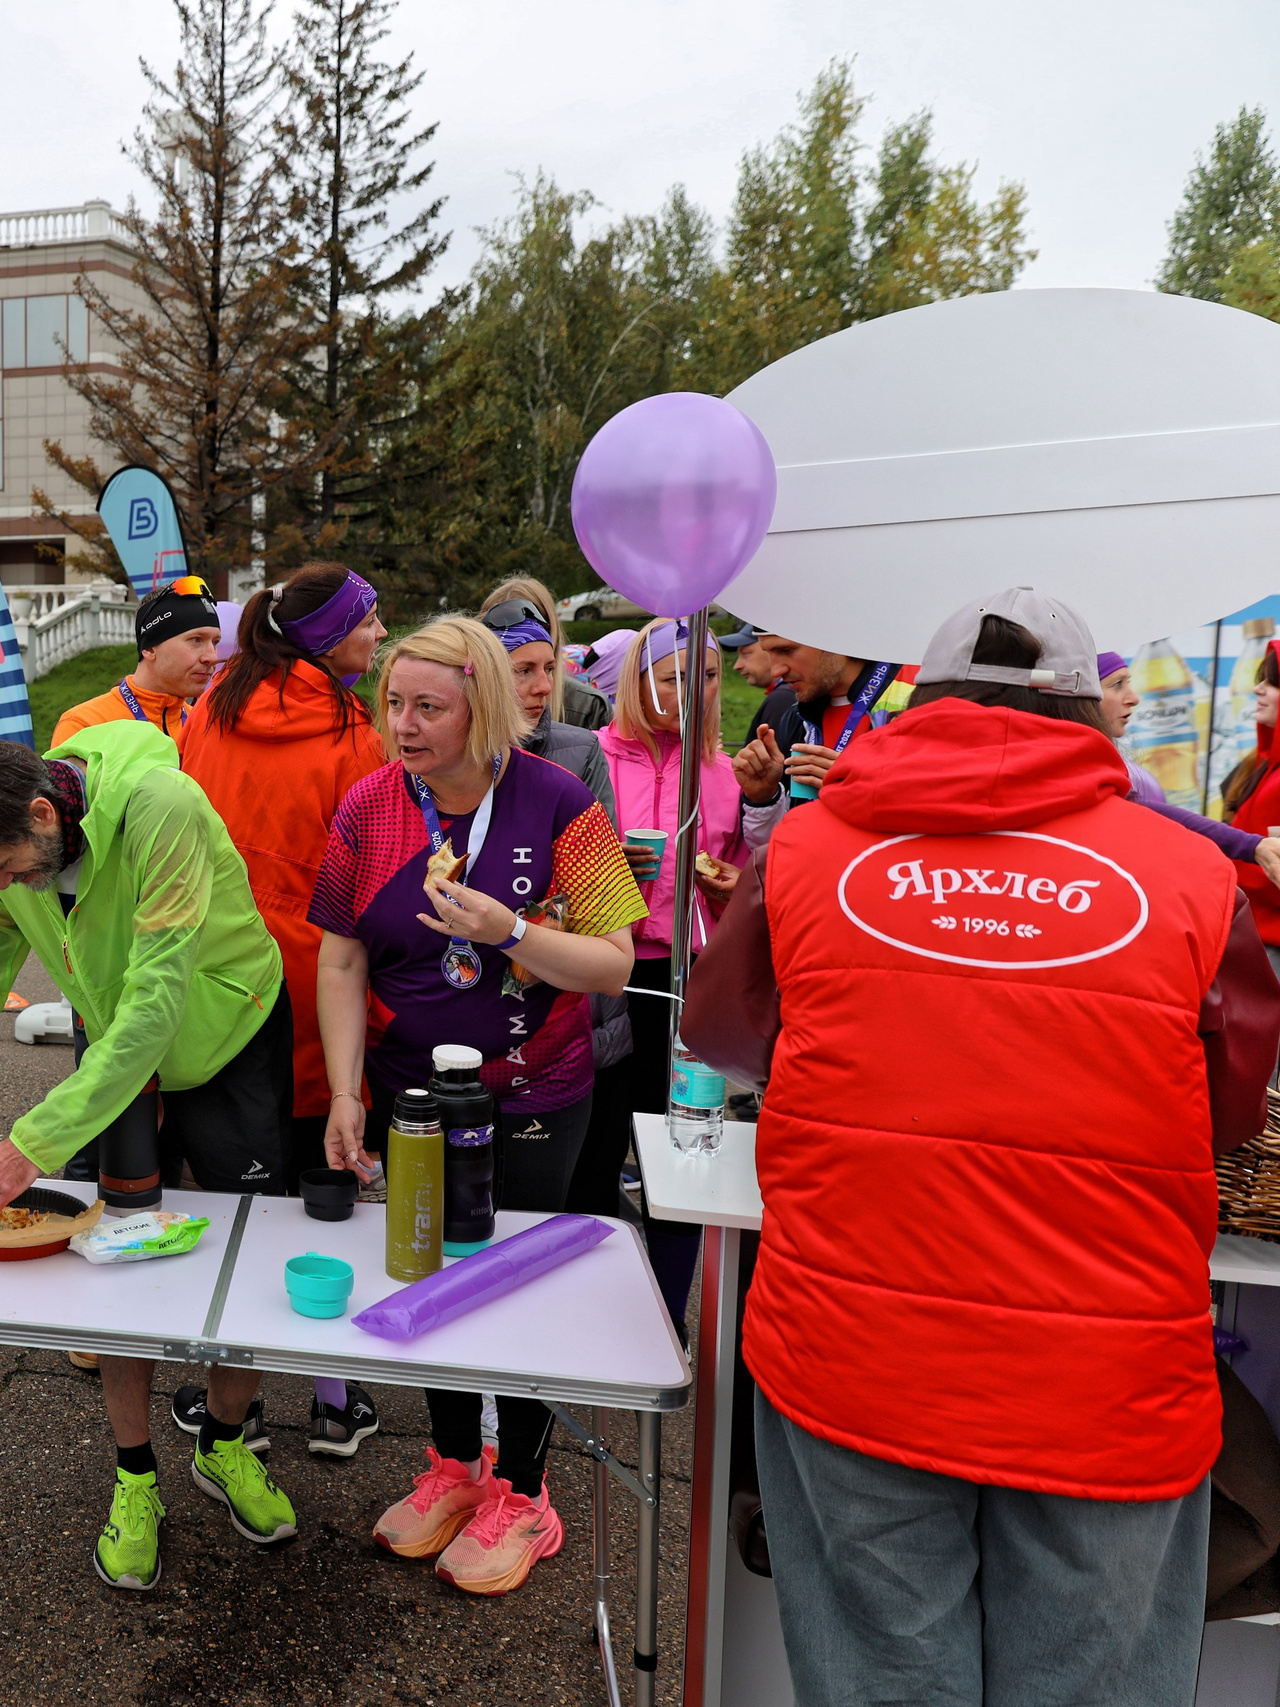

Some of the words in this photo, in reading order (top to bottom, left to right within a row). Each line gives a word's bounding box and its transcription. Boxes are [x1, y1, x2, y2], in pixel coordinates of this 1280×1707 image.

[858, 665, 888, 705] ЖИЗНЬ
[120, 683, 141, 714] ЖИЗНЬ
[839, 729, 853, 746] 2026
[886, 859, 1100, 914] Ярхлеб
[962, 916, 1010, 937] 1996
[512, 1132, 551, 1140] DEMIX
[241, 1172, 271, 1180] DEMIX
[113, 1222, 152, 1235] ДЕТСКИЕ
